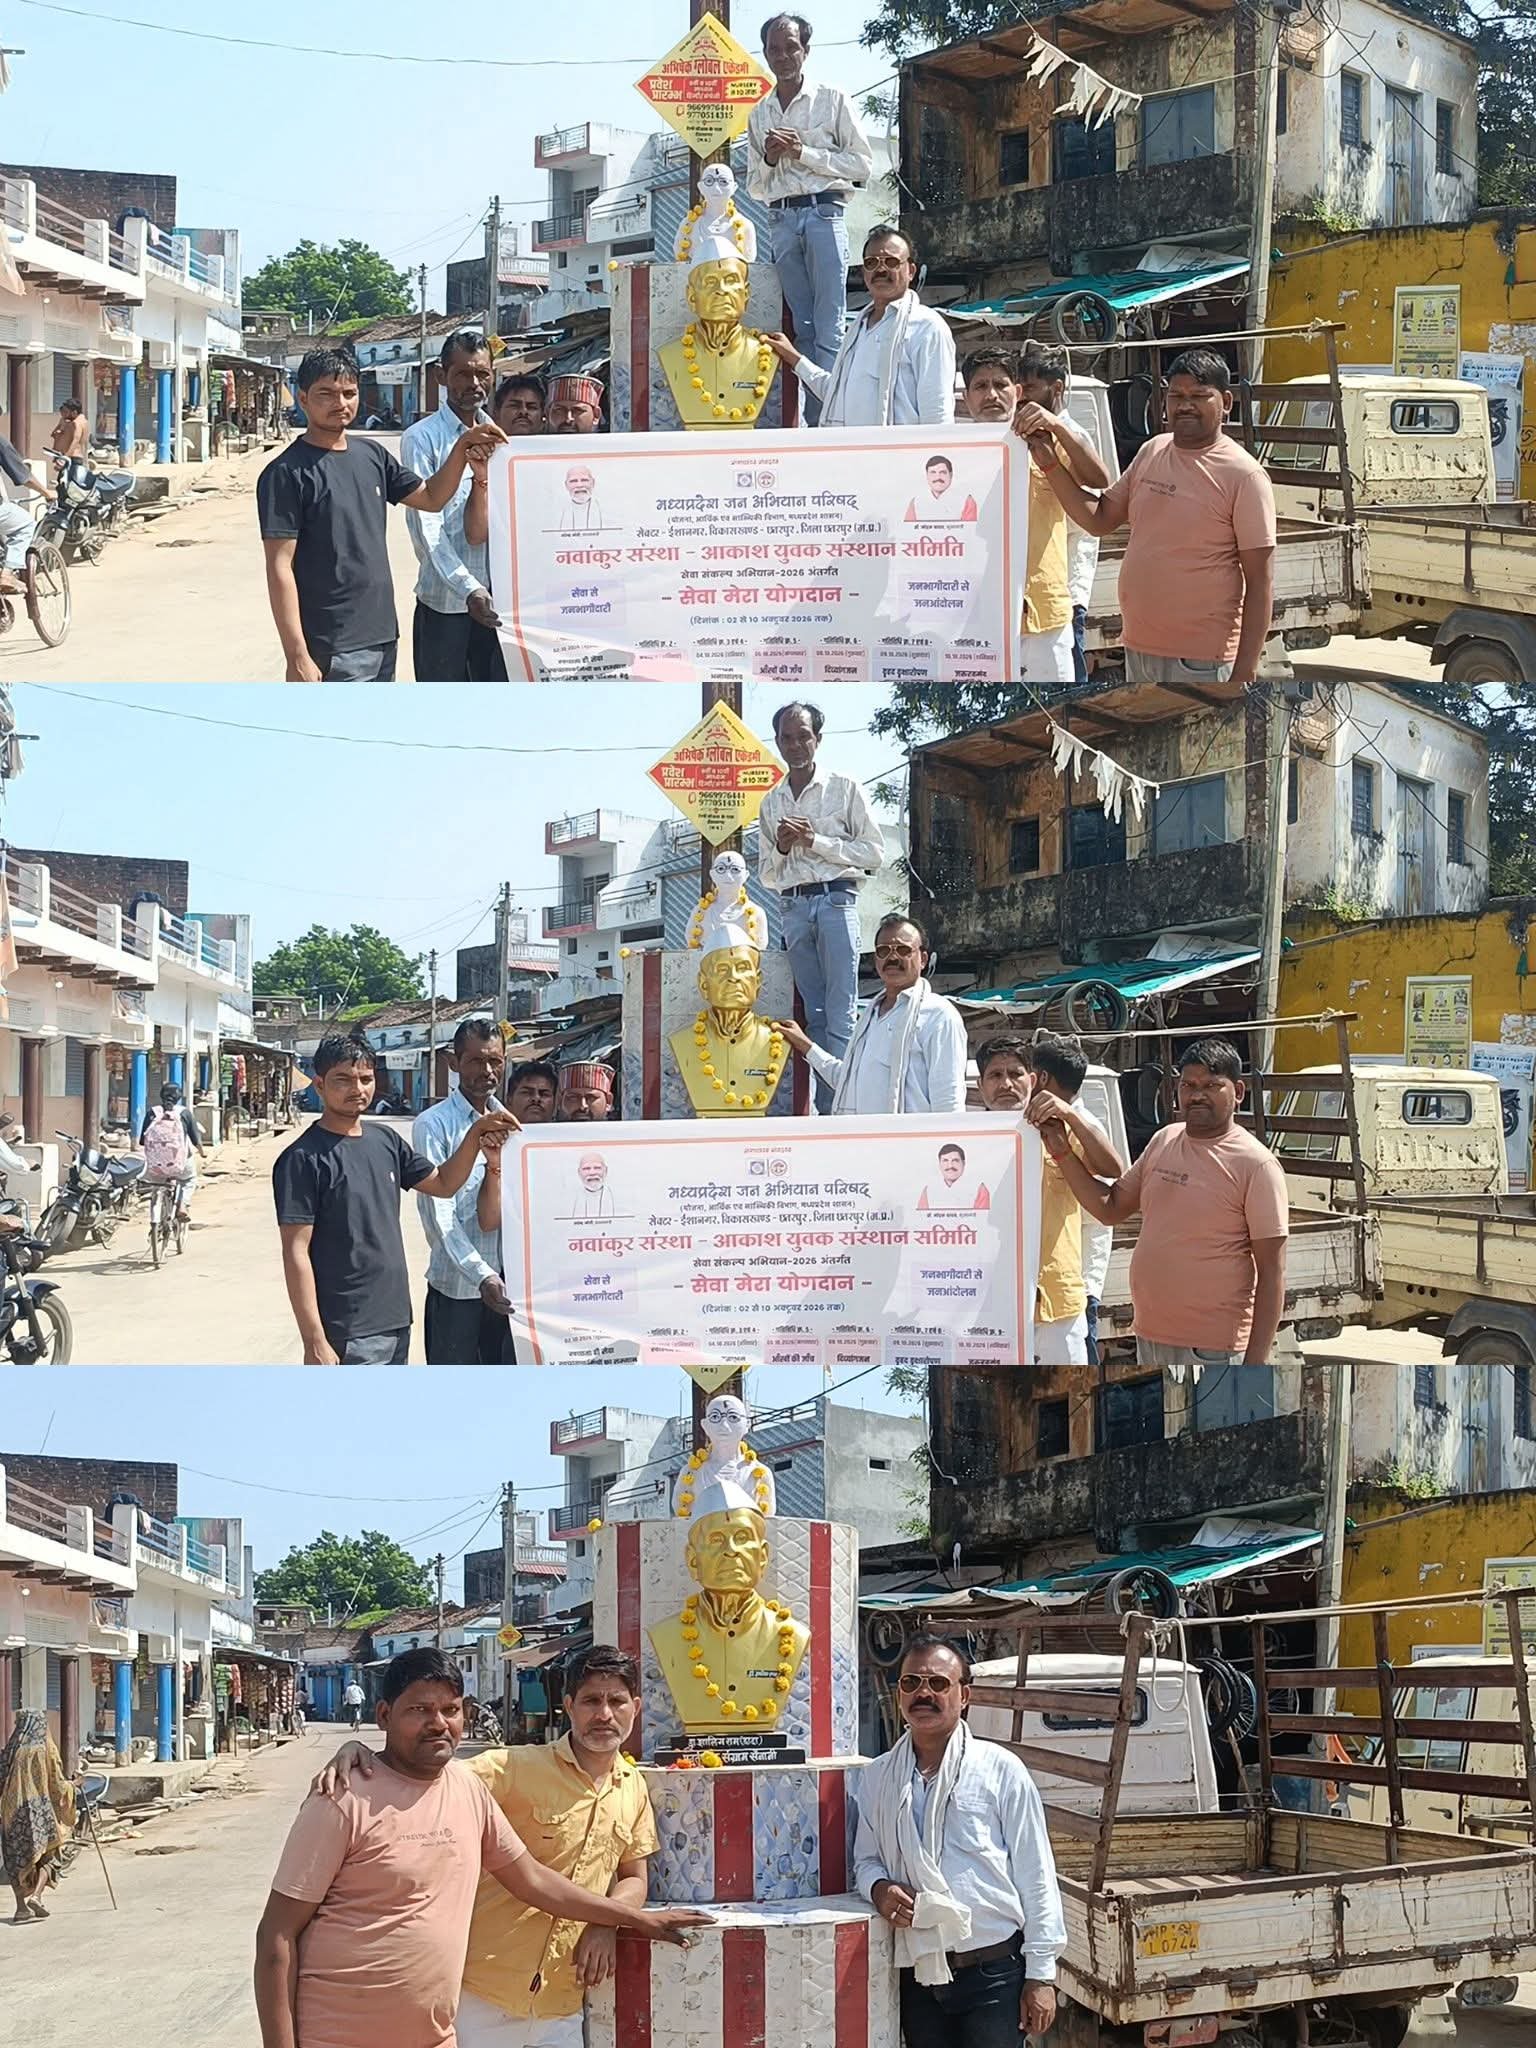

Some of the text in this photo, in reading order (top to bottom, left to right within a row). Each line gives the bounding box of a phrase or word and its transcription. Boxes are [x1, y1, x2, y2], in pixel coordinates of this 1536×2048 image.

[656, 494, 719, 512] मध्यप्रदेश
[724, 497, 747, 509] जन
[752, 492, 807, 508] अभियान
[800, 522, 822, 533] जिला
[556, 535, 965, 569] नवांकुर संस्था आकाश युवक संस्थान समिति
[680, 569, 699, 579] सेवा
[701, 568, 733, 578] संकल्प
[808, 566, 839, 576] अंतर्गत
[571, 586, 599, 598] सेवा से
[907, 580, 970, 592] जनभागीदारी से
[678, 583, 842, 605] सेवा मेरा योगदान
[561, 602, 612, 616] जनभागीदारी
[668, 1182, 732, 1200] मध्यप्रदेश
[736, 1184, 760, 1197] जन
[765, 1180, 819, 1196] अभियान
[813, 1210, 835, 1221] जिला
[568, 1223, 977, 1257] नवांकुर संस्था आकाश युवक संस्थान समिति
[693, 1257, 711, 1267] सेवा
[713, 1256, 745, 1267] संकल्प
[820, 1254, 851, 1264] अंतर्गत
[584, 1274, 611, 1285] सेवा से
[920, 1268, 983, 1280] जनभागीदारी से
[690, 1271, 855, 1293] सेवा मेरा योगदान
[573, 1289, 624, 1302] जनभागीदारी
